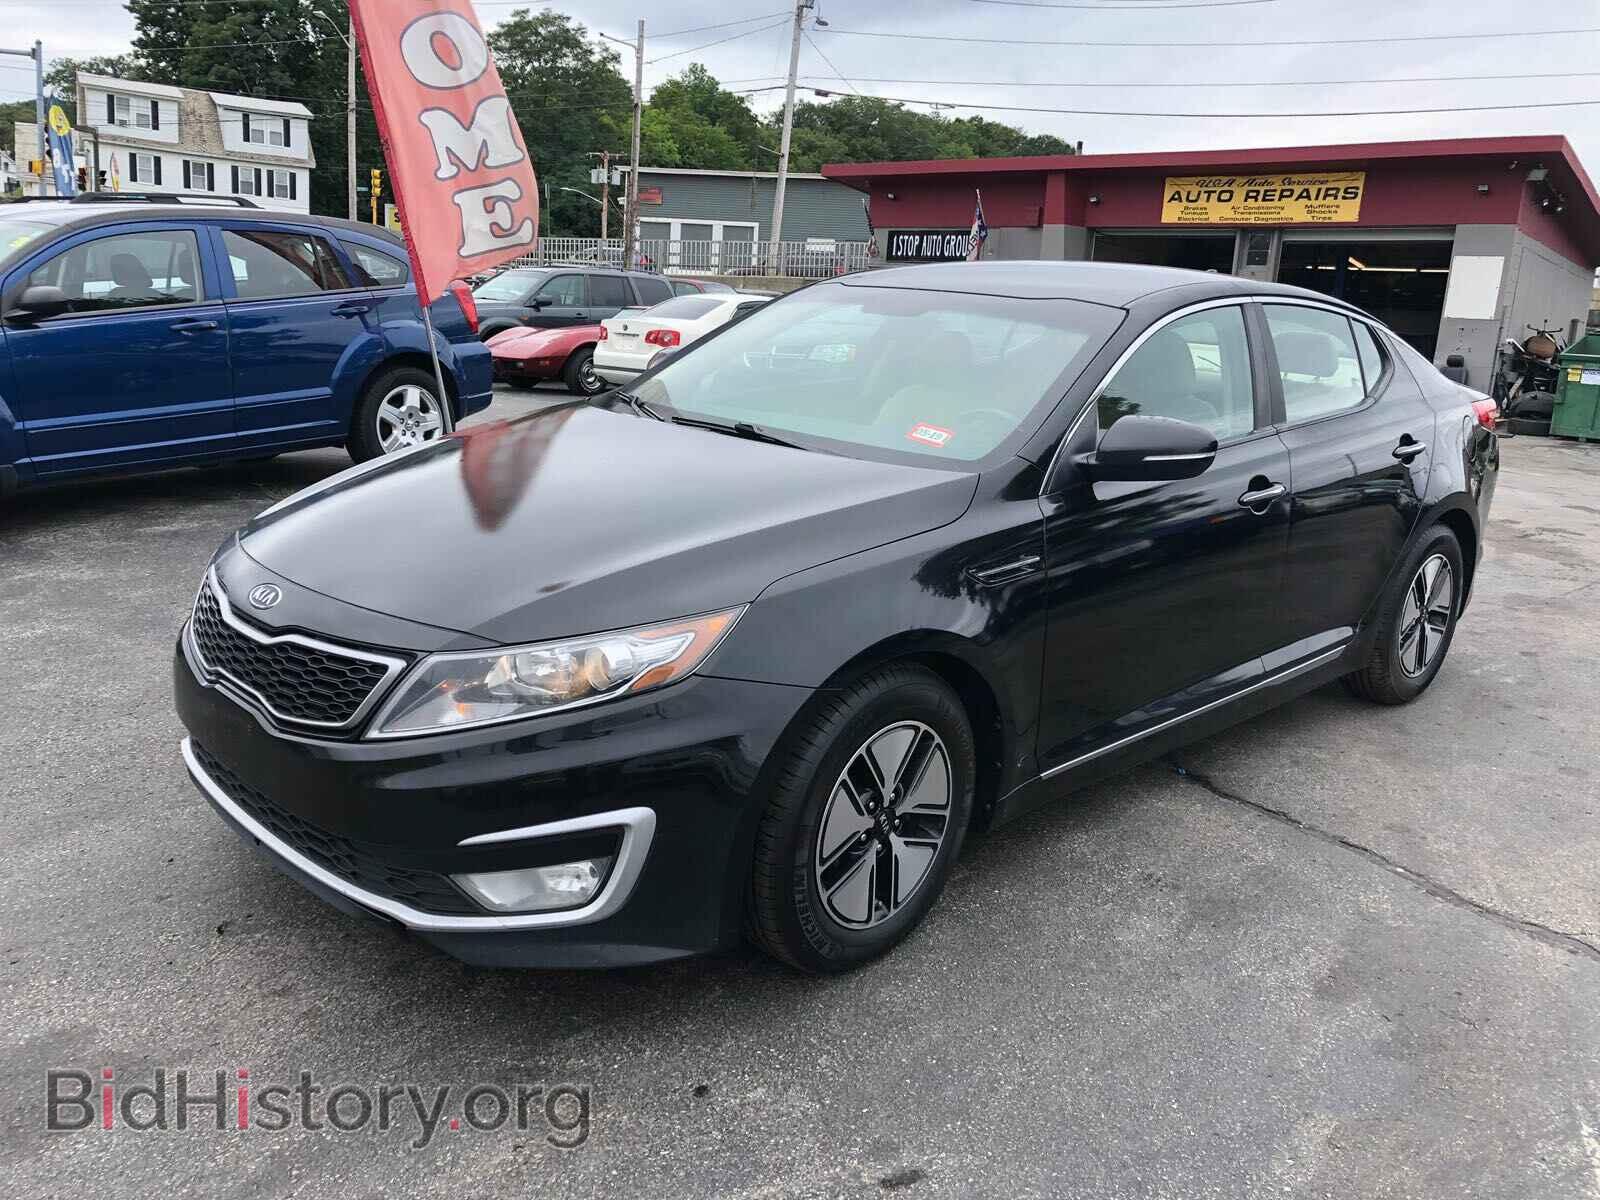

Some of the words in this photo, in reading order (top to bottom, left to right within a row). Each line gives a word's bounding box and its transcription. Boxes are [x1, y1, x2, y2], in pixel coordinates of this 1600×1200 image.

[1238, 178, 1275, 188] Auto
[1279, 176, 1330, 187] Service
[1168, 188, 1235, 204] AUTO
[1244, 186, 1360, 203] REPAIRS
[897, 234, 919, 257] STOP
[921, 234, 942, 257] AUTO
[943, 234, 969, 257] GROU
